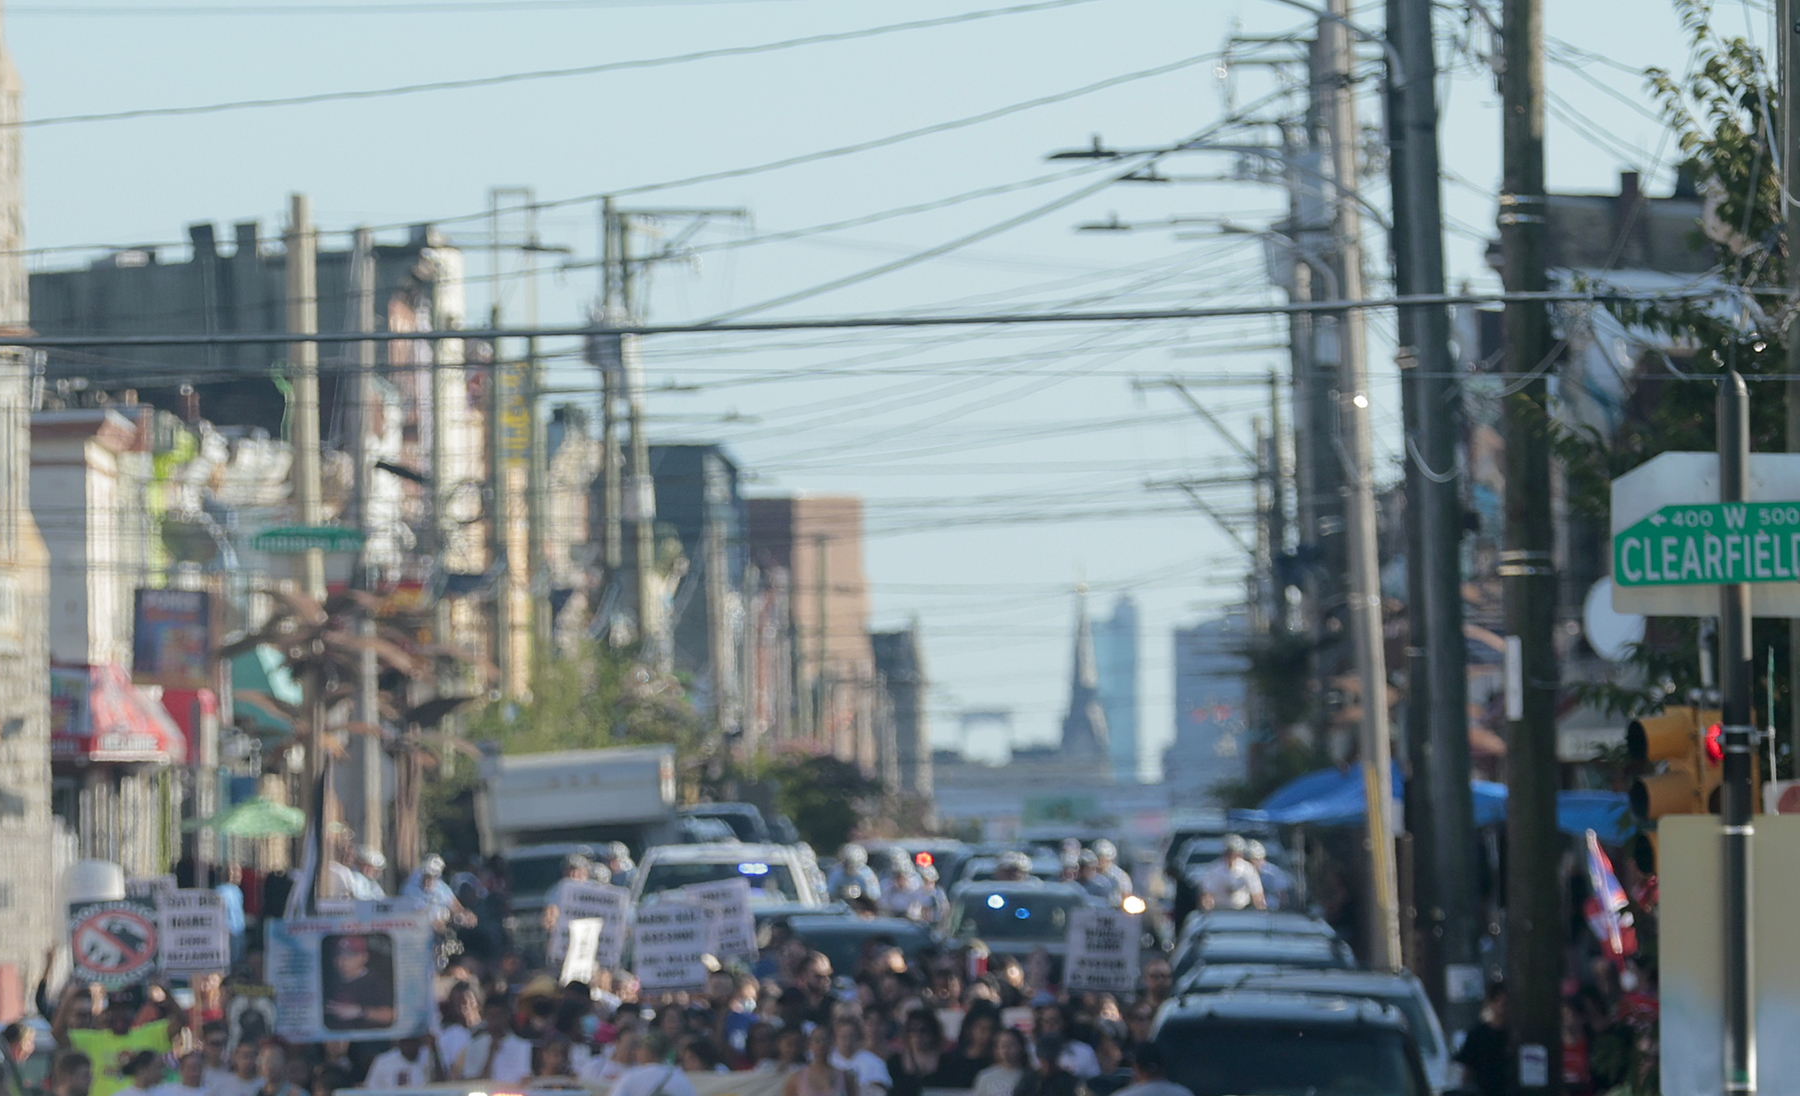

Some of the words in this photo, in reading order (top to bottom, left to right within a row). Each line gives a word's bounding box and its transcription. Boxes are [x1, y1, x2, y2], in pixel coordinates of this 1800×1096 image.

[1671, 510, 1714, 528] 400
[1722, 506, 1747, 529] W
[1758, 507, 1799, 526] 500
